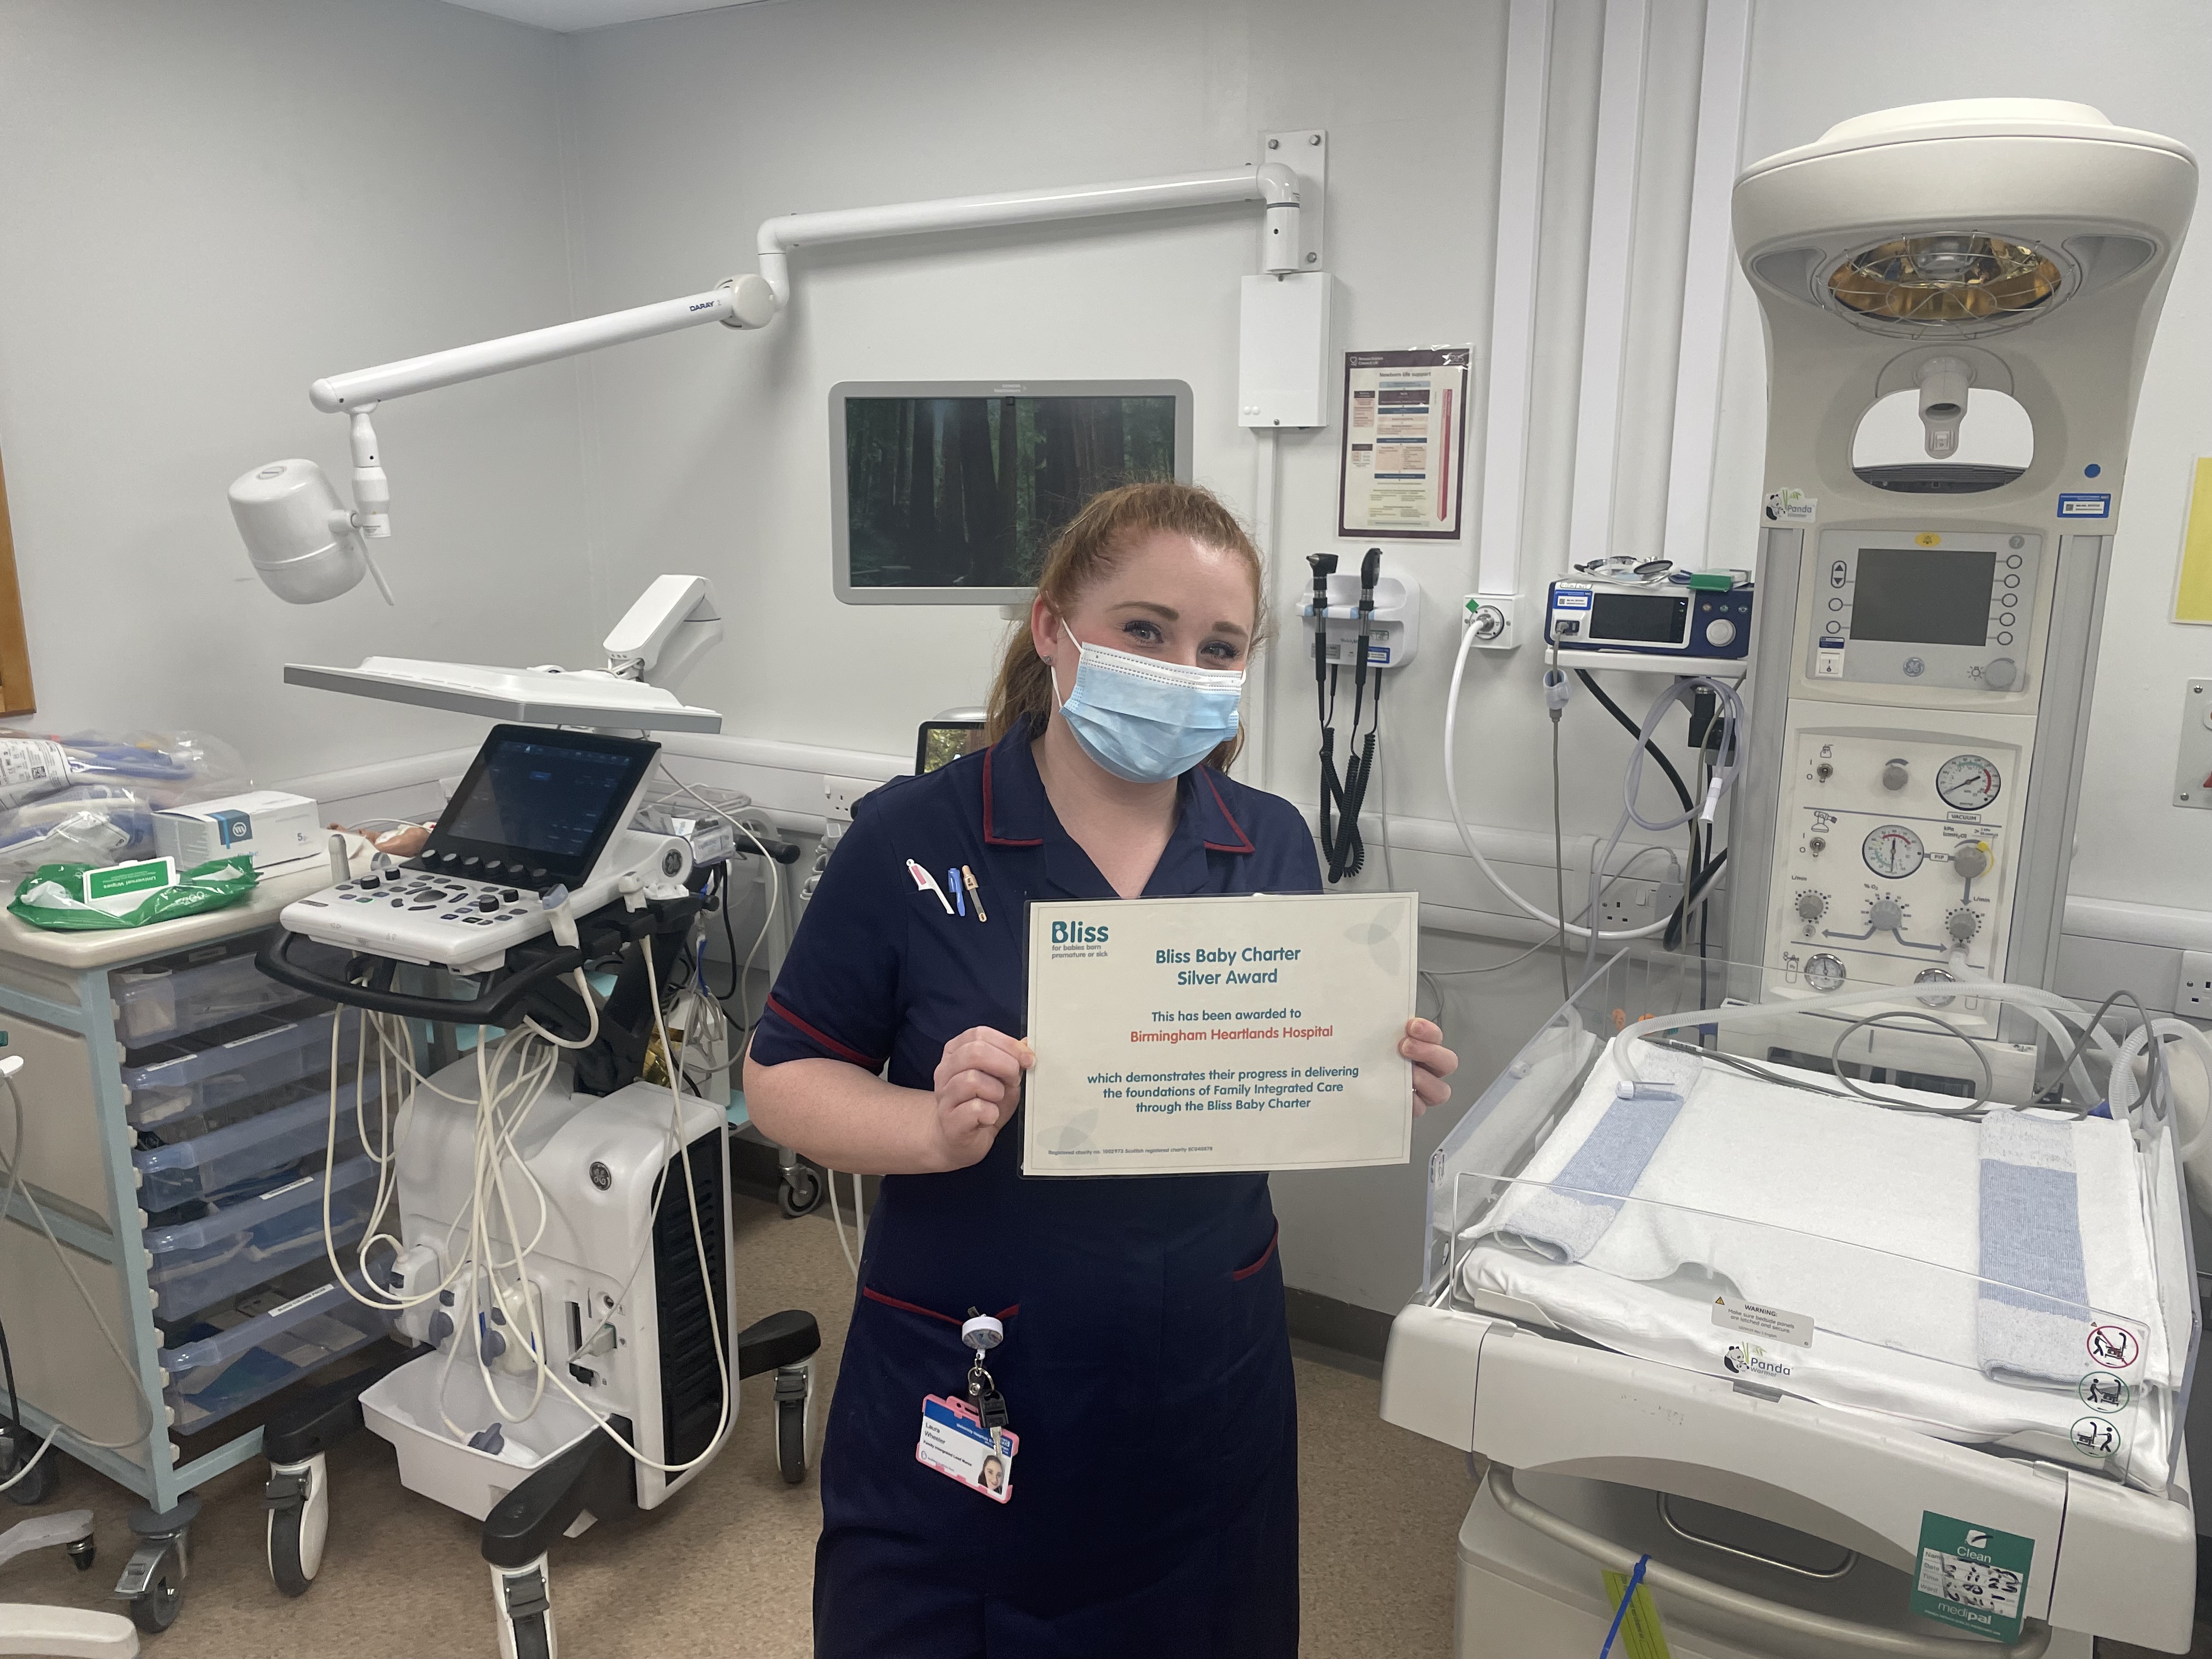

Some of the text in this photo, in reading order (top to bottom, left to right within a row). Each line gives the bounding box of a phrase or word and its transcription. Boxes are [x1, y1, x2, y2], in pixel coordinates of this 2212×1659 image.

[689, 301, 714, 312] DARAY
[103, 881, 124, 889] Wipes
[125, 876, 156, 885] Universal
[1052, 921, 1108, 943] Bliss
[1156, 947, 1301, 966] Bliss Baby Charter
[1178, 968, 1277, 985] Silver Award
[1152, 1008, 1301, 1022] This has been awarded to
[1131, 1025, 1333, 1044] Birmingham Heartlands Hospital
[1087, 1066, 1358, 1083] which demonstrates their progress in delivering
[1103, 1082, 1343, 1098] the foundations of Family Integrated Care
[1136, 1098, 1311, 1114] through the Bliss Baby Charter
[1745, 1305, 1778, 1317] WARNING:
[1740, 1317, 1760, 1325] latched
[1773, 1324, 1791, 1333] secure.
[1756, 1316, 1776, 1324] bedside
[1777, 1321, 1795, 1329] panels
[1751, 1358, 1790, 1375] Panda
[1751, 1367, 1776, 1378] Warmer
[926, 1422, 940, 1434] Laura
[923, 1440, 934, 1448] Family
[924, 1430, 945, 1444] Wheeler
[1926, 1551, 1944, 1560] Nam
[1957, 1546, 1991, 1563] Clean
[1924, 1563, 1940, 1572] Date
[1922, 1573, 1939, 1582] Time
[1920, 1584, 1938, 1593] Ward
[1938, 1602, 1991, 1625] medipal
